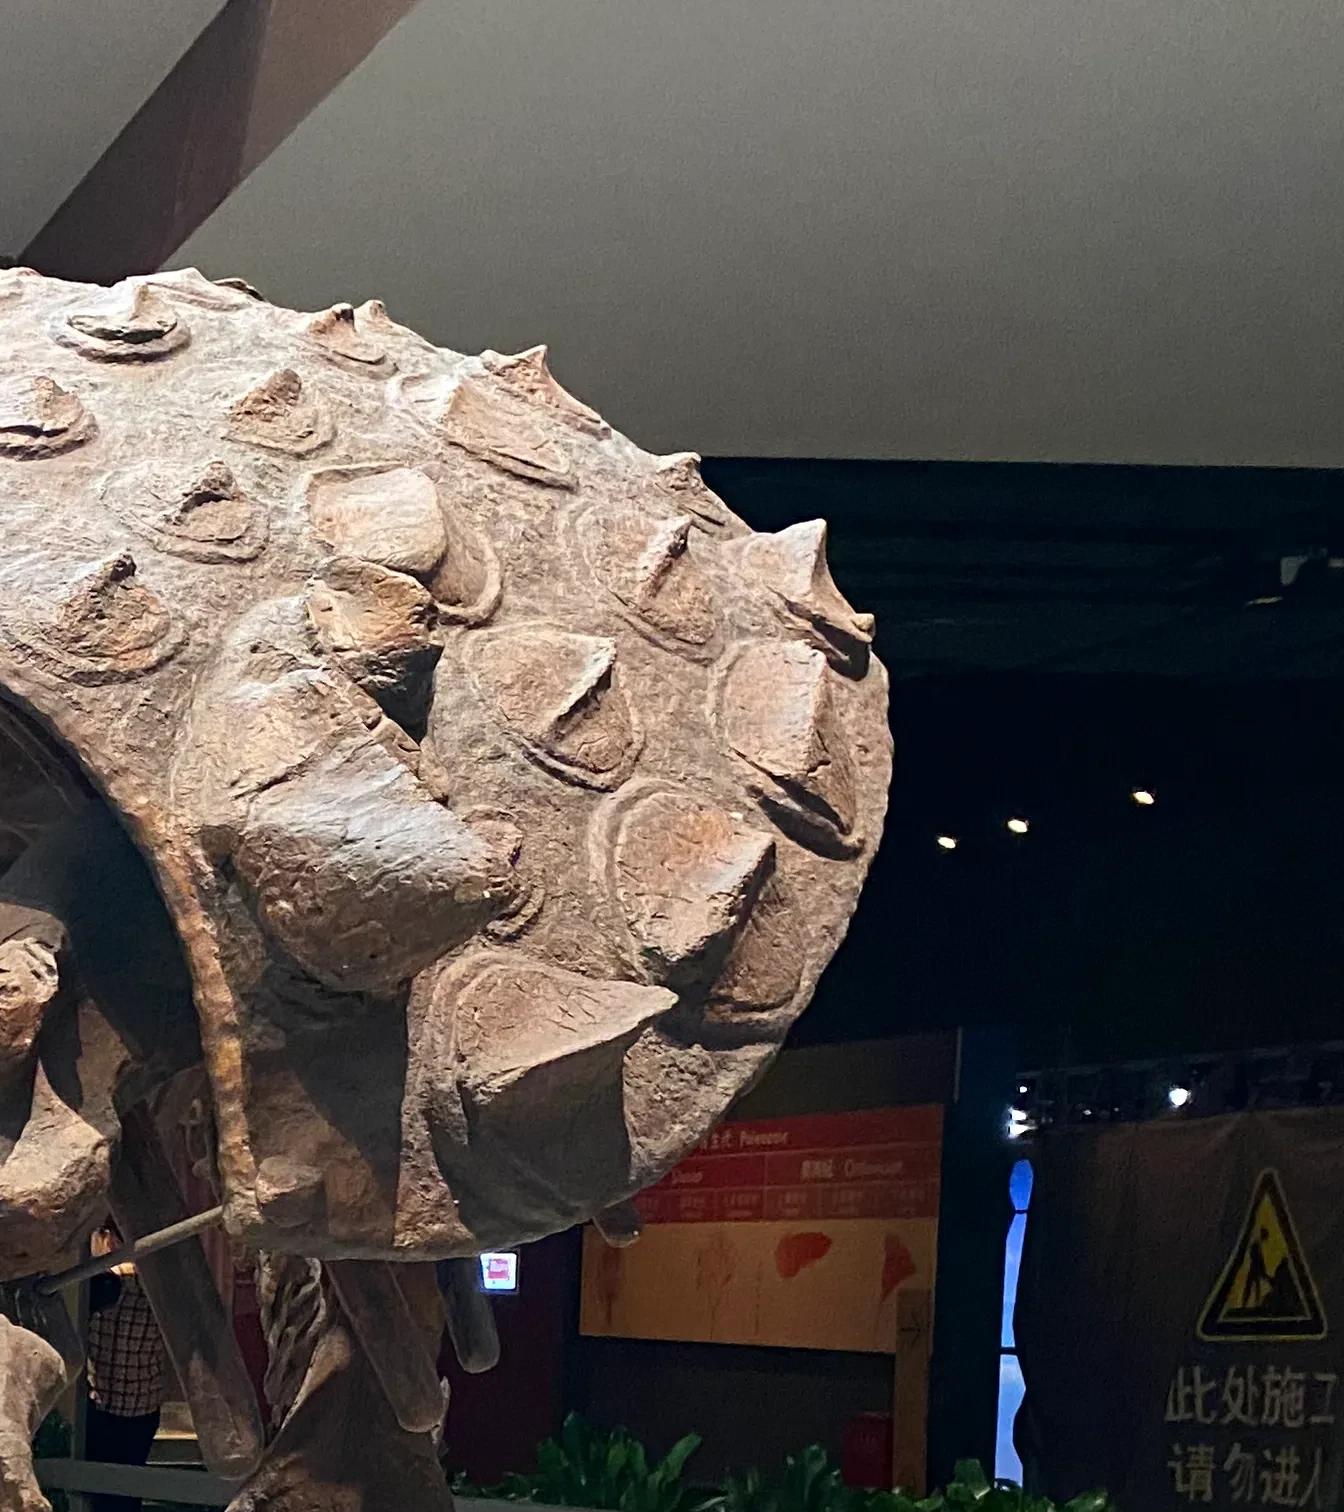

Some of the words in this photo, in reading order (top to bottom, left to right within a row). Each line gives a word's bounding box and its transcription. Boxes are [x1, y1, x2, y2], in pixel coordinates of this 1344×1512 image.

[1164, 1364, 1338, 1429] 此处施工
[1167, 1441, 1324, 1509] 请勿进入
